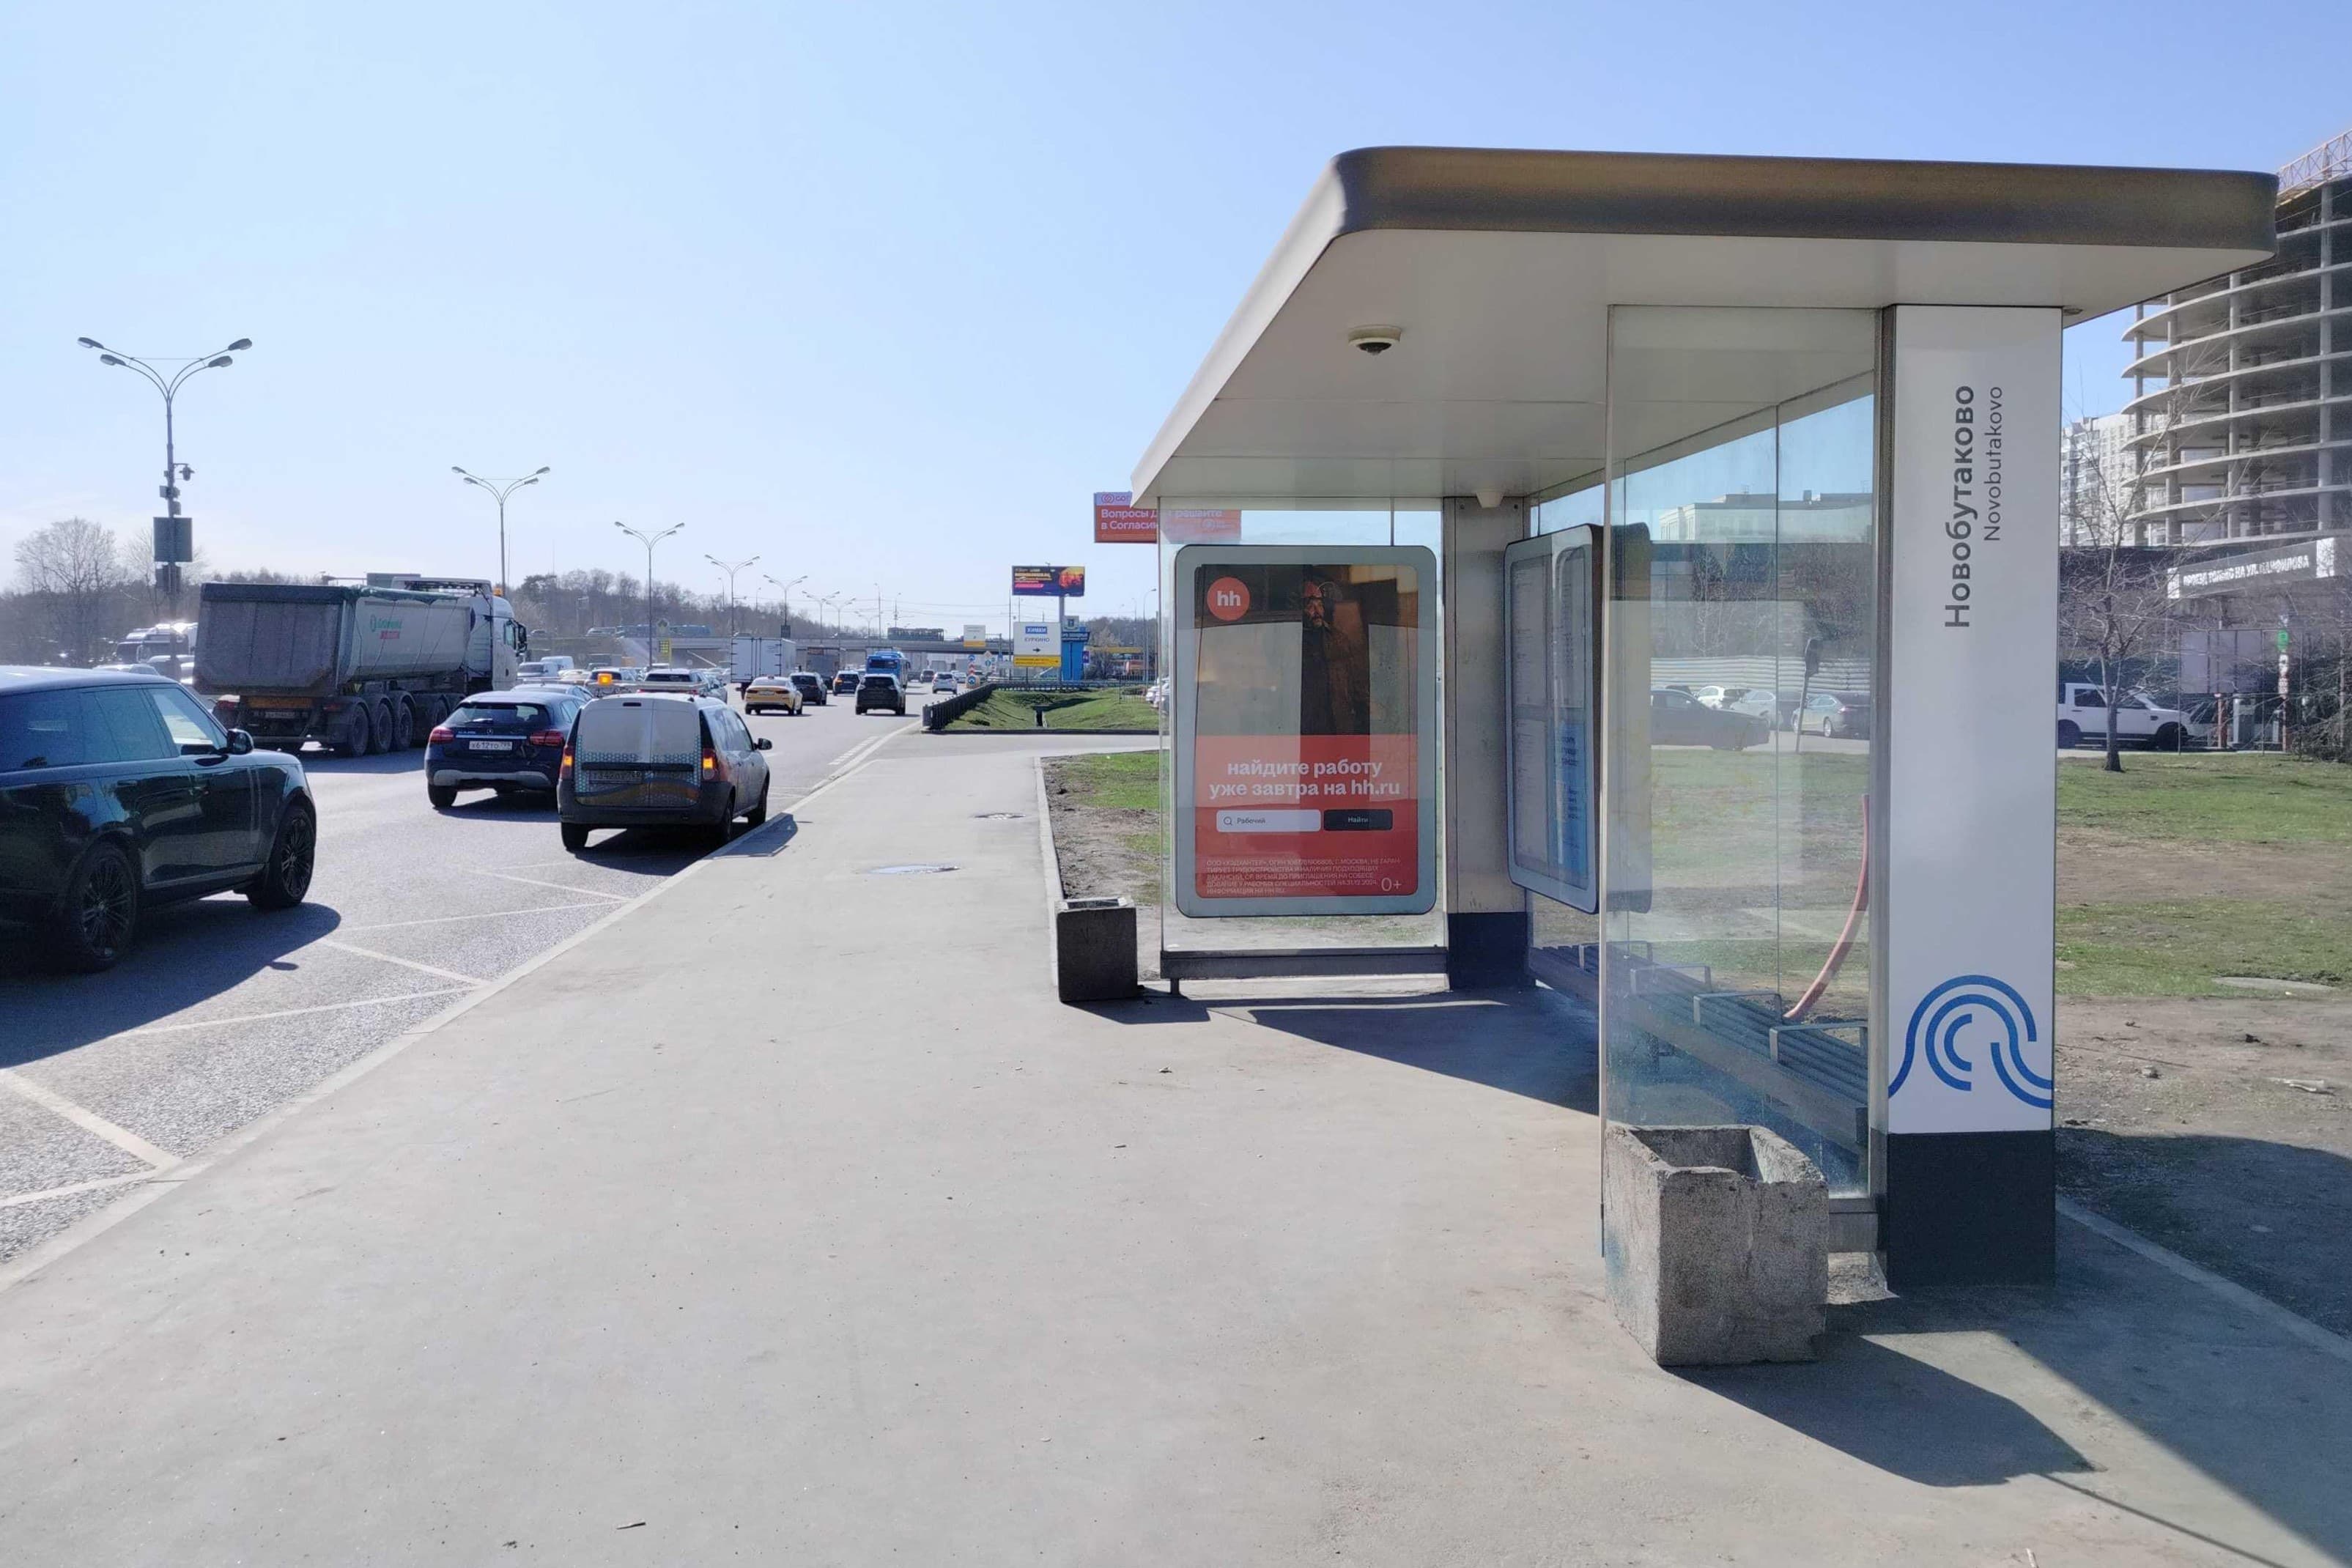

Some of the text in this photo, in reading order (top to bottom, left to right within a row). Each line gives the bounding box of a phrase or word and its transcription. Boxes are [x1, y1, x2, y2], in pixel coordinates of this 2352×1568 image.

[1983, 386, 2003, 541] Novobutakovo
[1101, 509, 1149, 519] Вопросы
[1945, 385, 1978, 628] Новобутаково
[1217, 591, 1240, 606] hh
[1227, 758, 1383, 778] найдите работу
[1209, 779, 1401, 799] уже завтра на hh.ru
[1381, 877, 1402, 892] 0+
